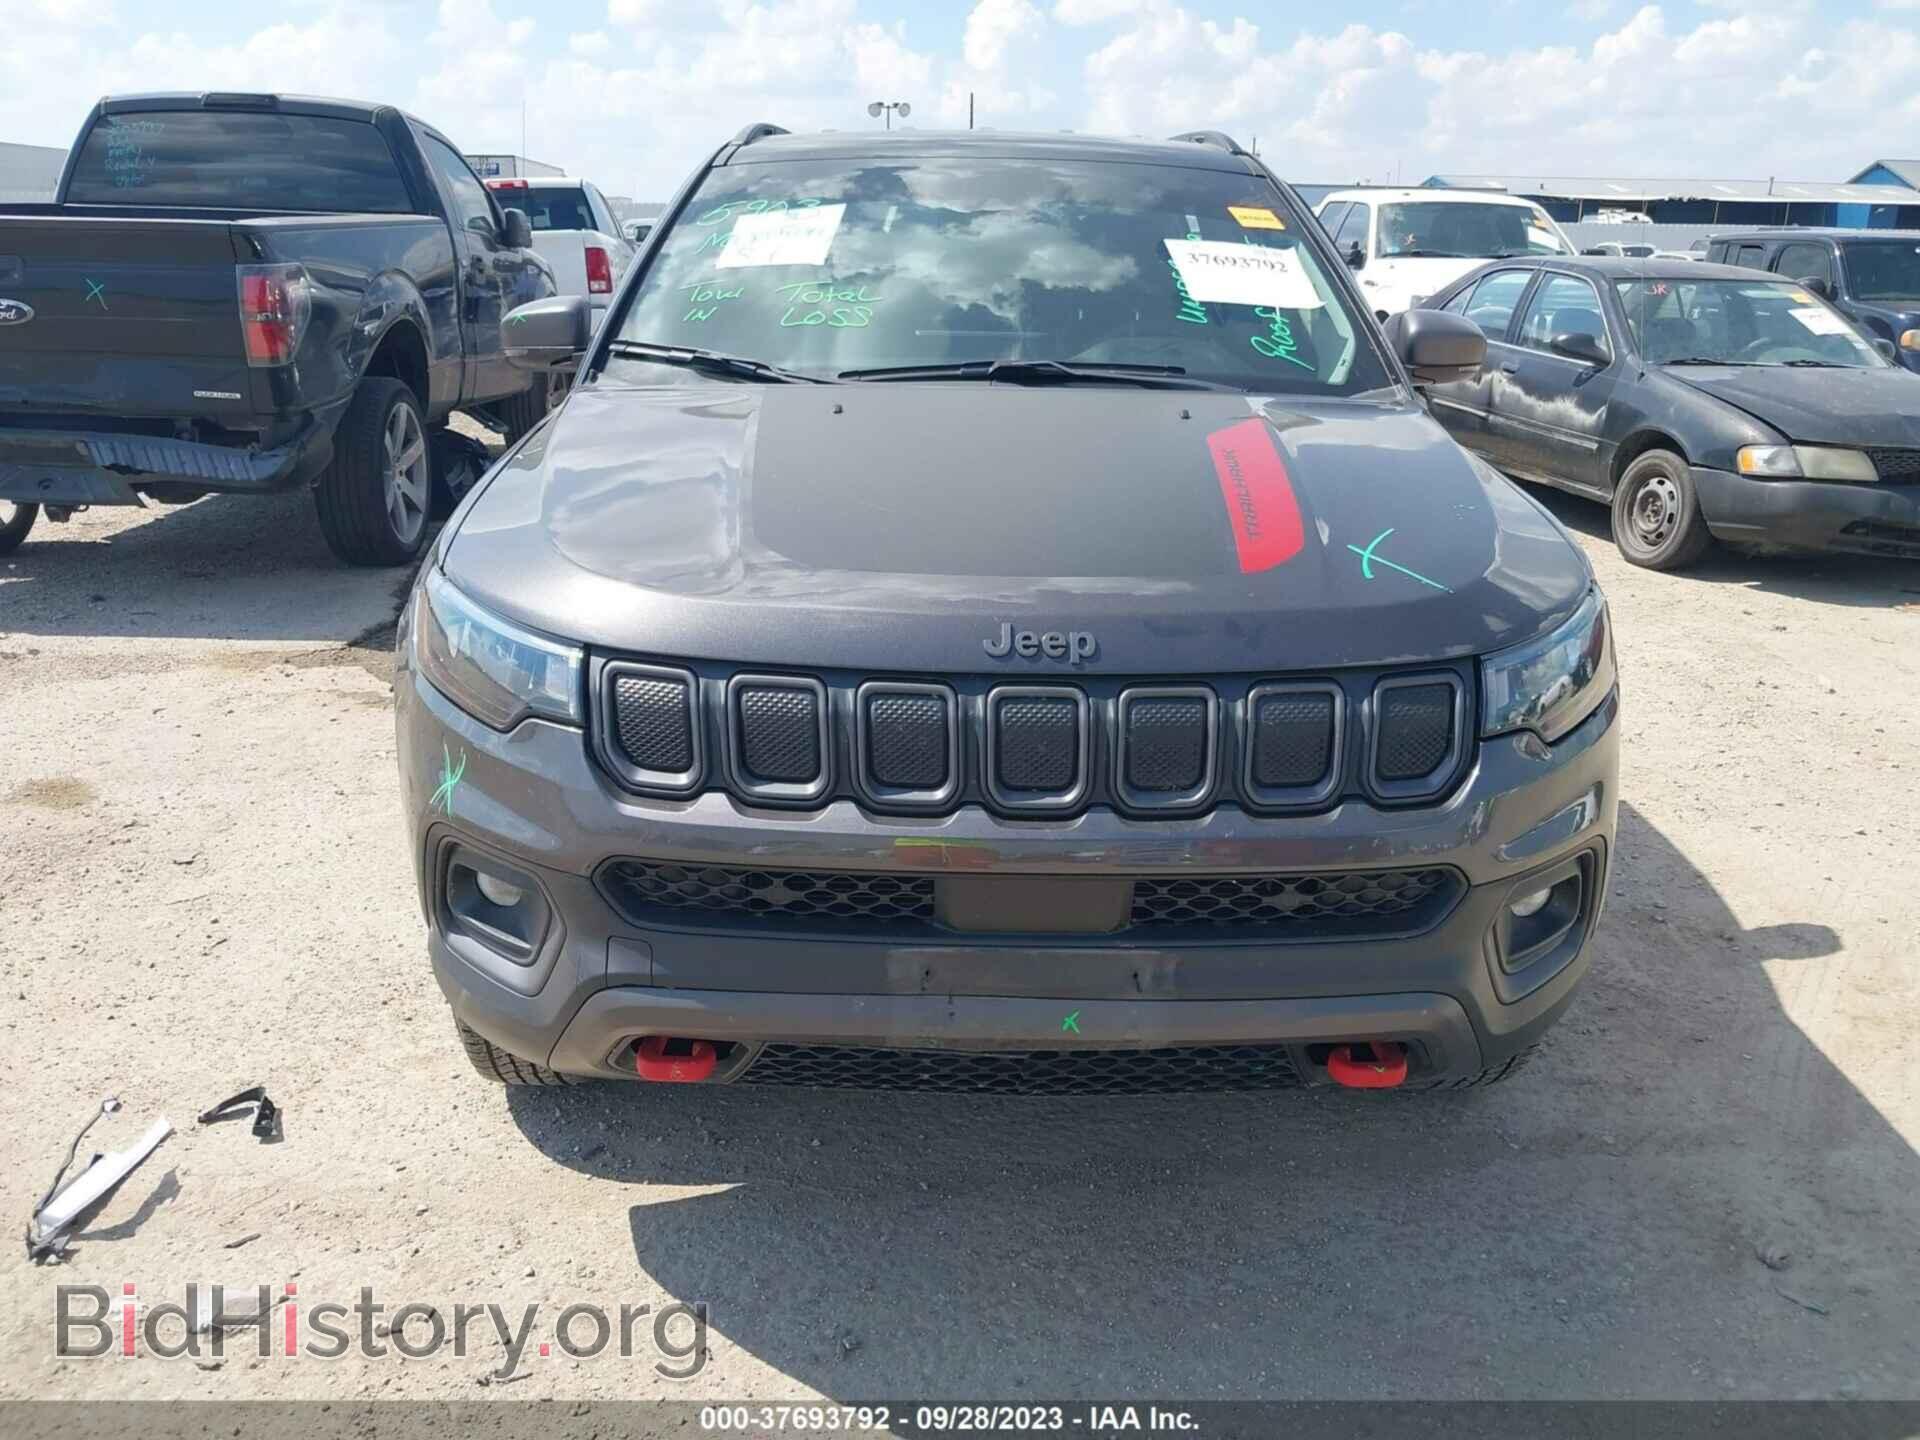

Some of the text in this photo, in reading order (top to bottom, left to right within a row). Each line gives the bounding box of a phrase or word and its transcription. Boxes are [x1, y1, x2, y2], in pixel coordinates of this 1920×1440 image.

[1186, 252, 1289, 274] 37693792
[780, 306, 874, 327] LOSS
[983, 622, 1097, 664] Jeep
